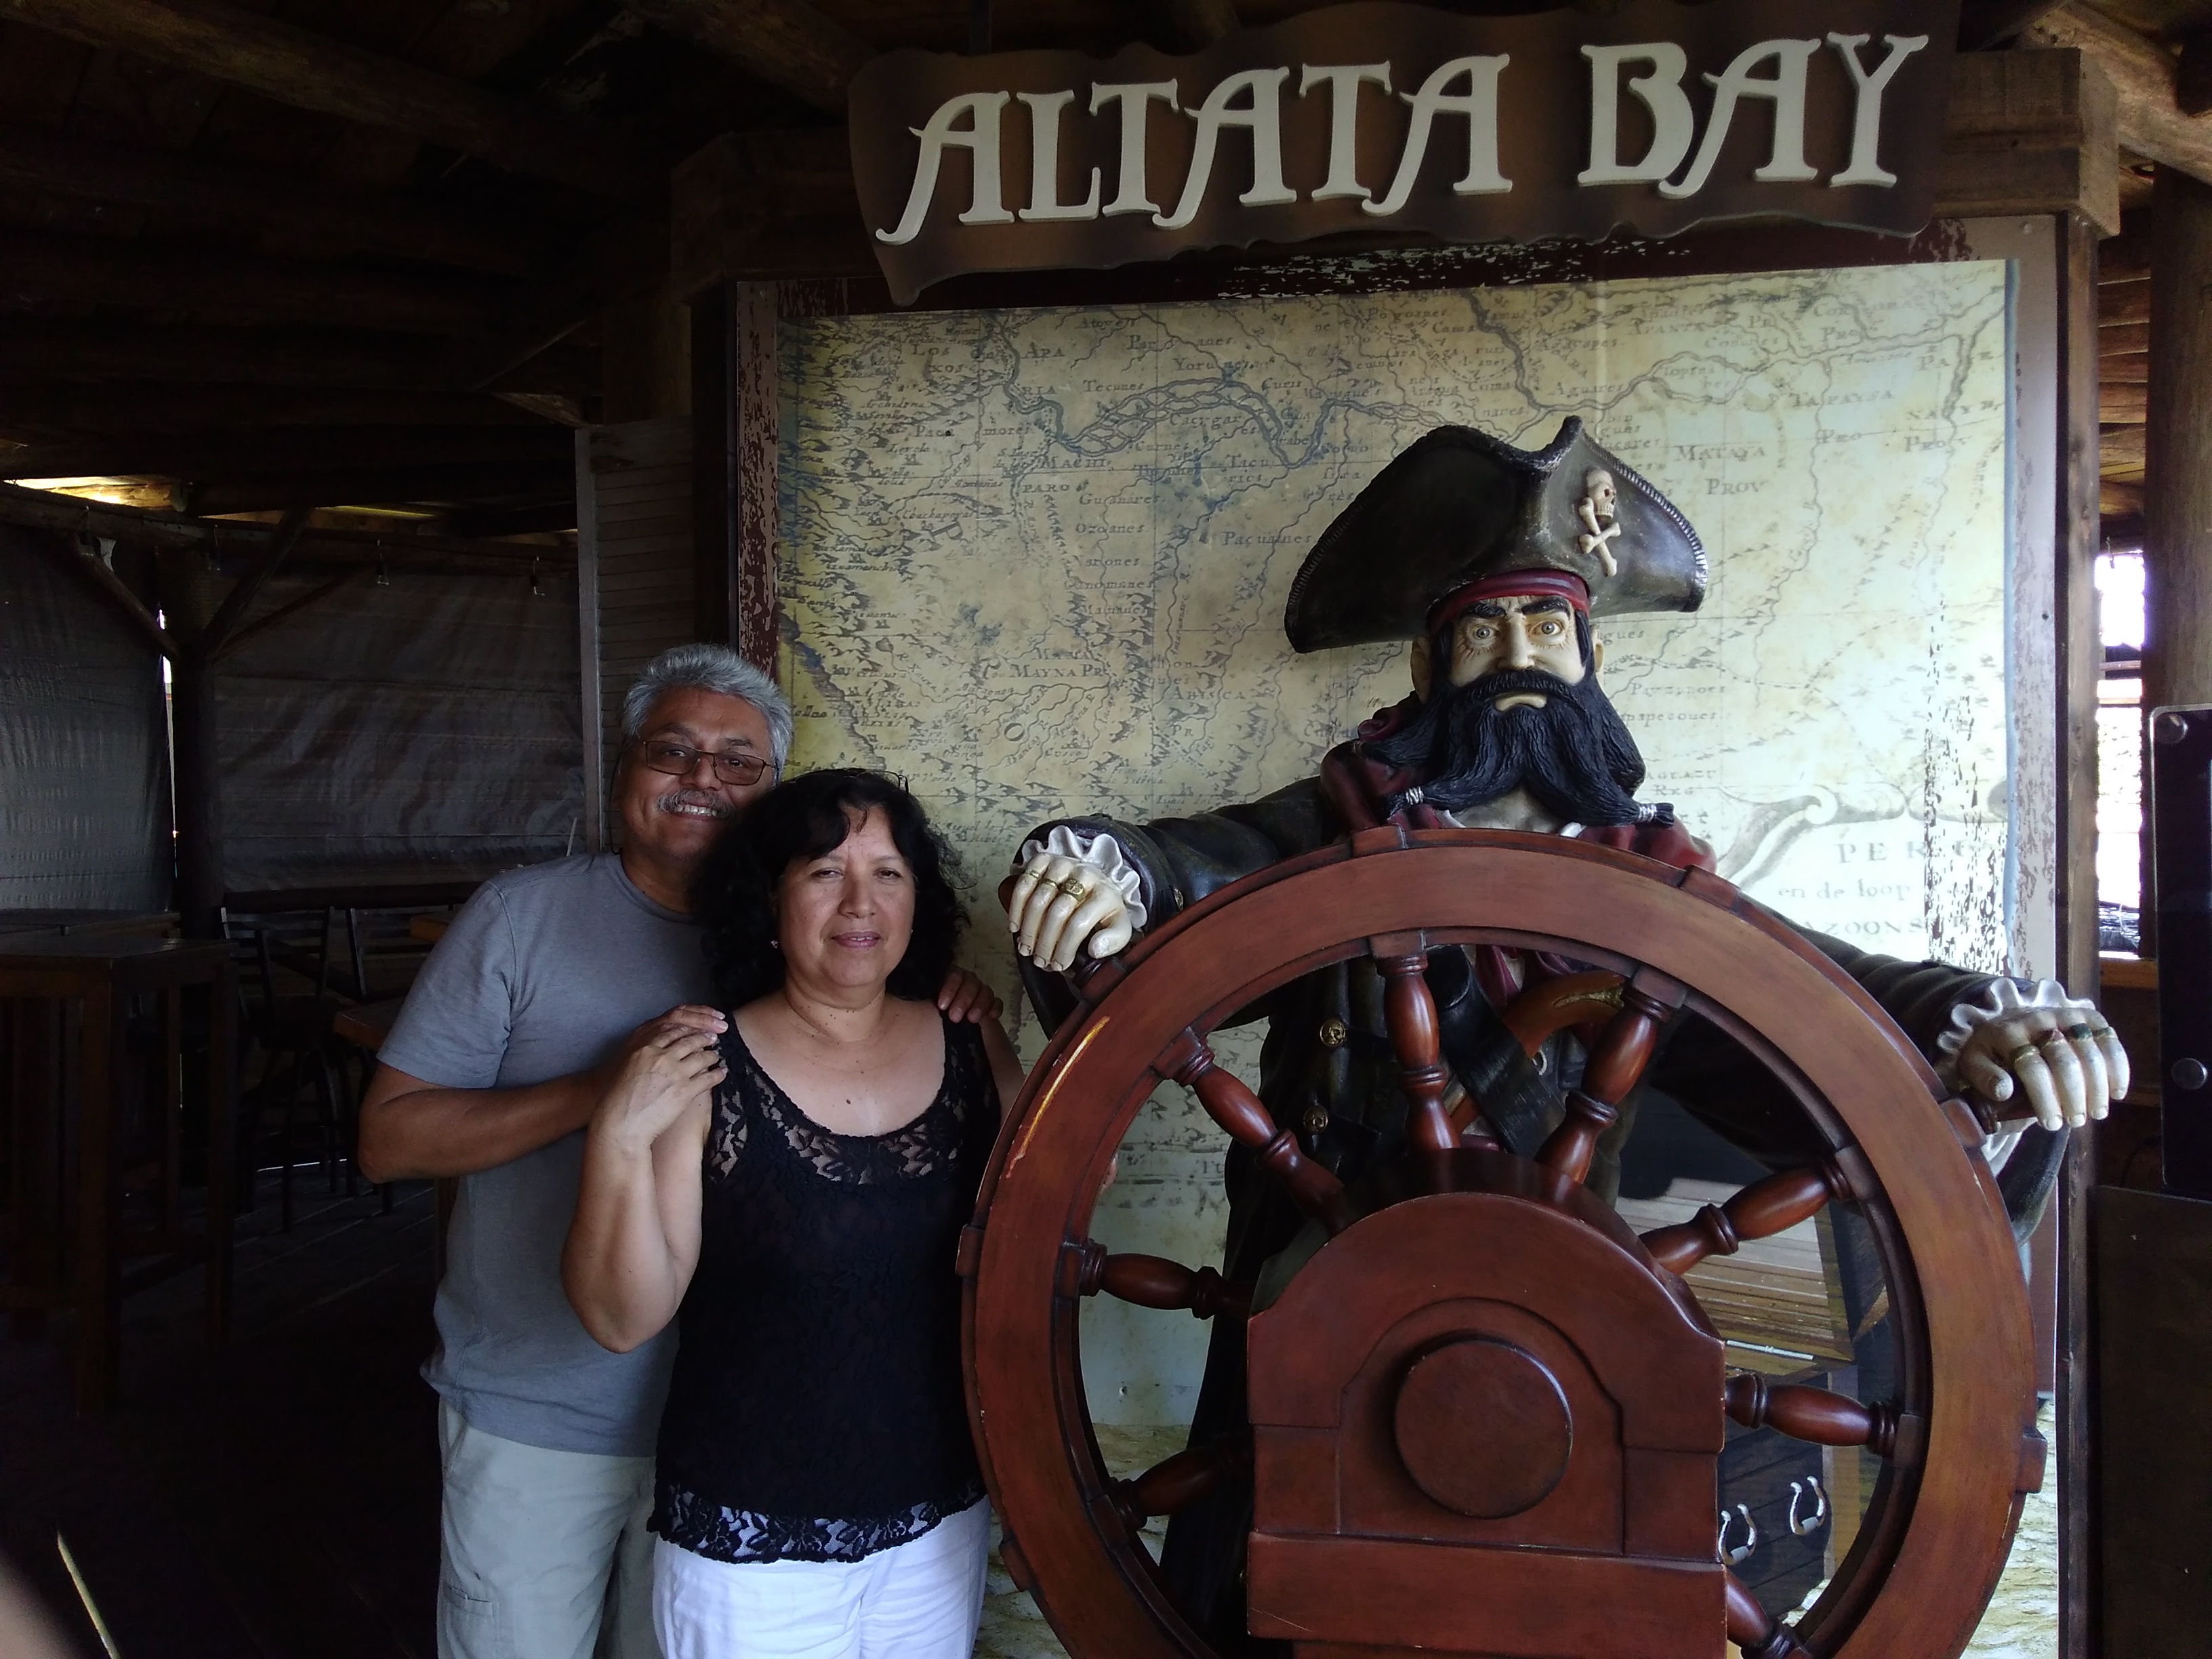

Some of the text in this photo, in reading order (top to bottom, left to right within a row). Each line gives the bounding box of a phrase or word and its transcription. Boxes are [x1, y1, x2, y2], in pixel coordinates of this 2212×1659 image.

[875, 31, 1929, 245] ALTATA BAY
[1816, 881, 1845, 900] de
